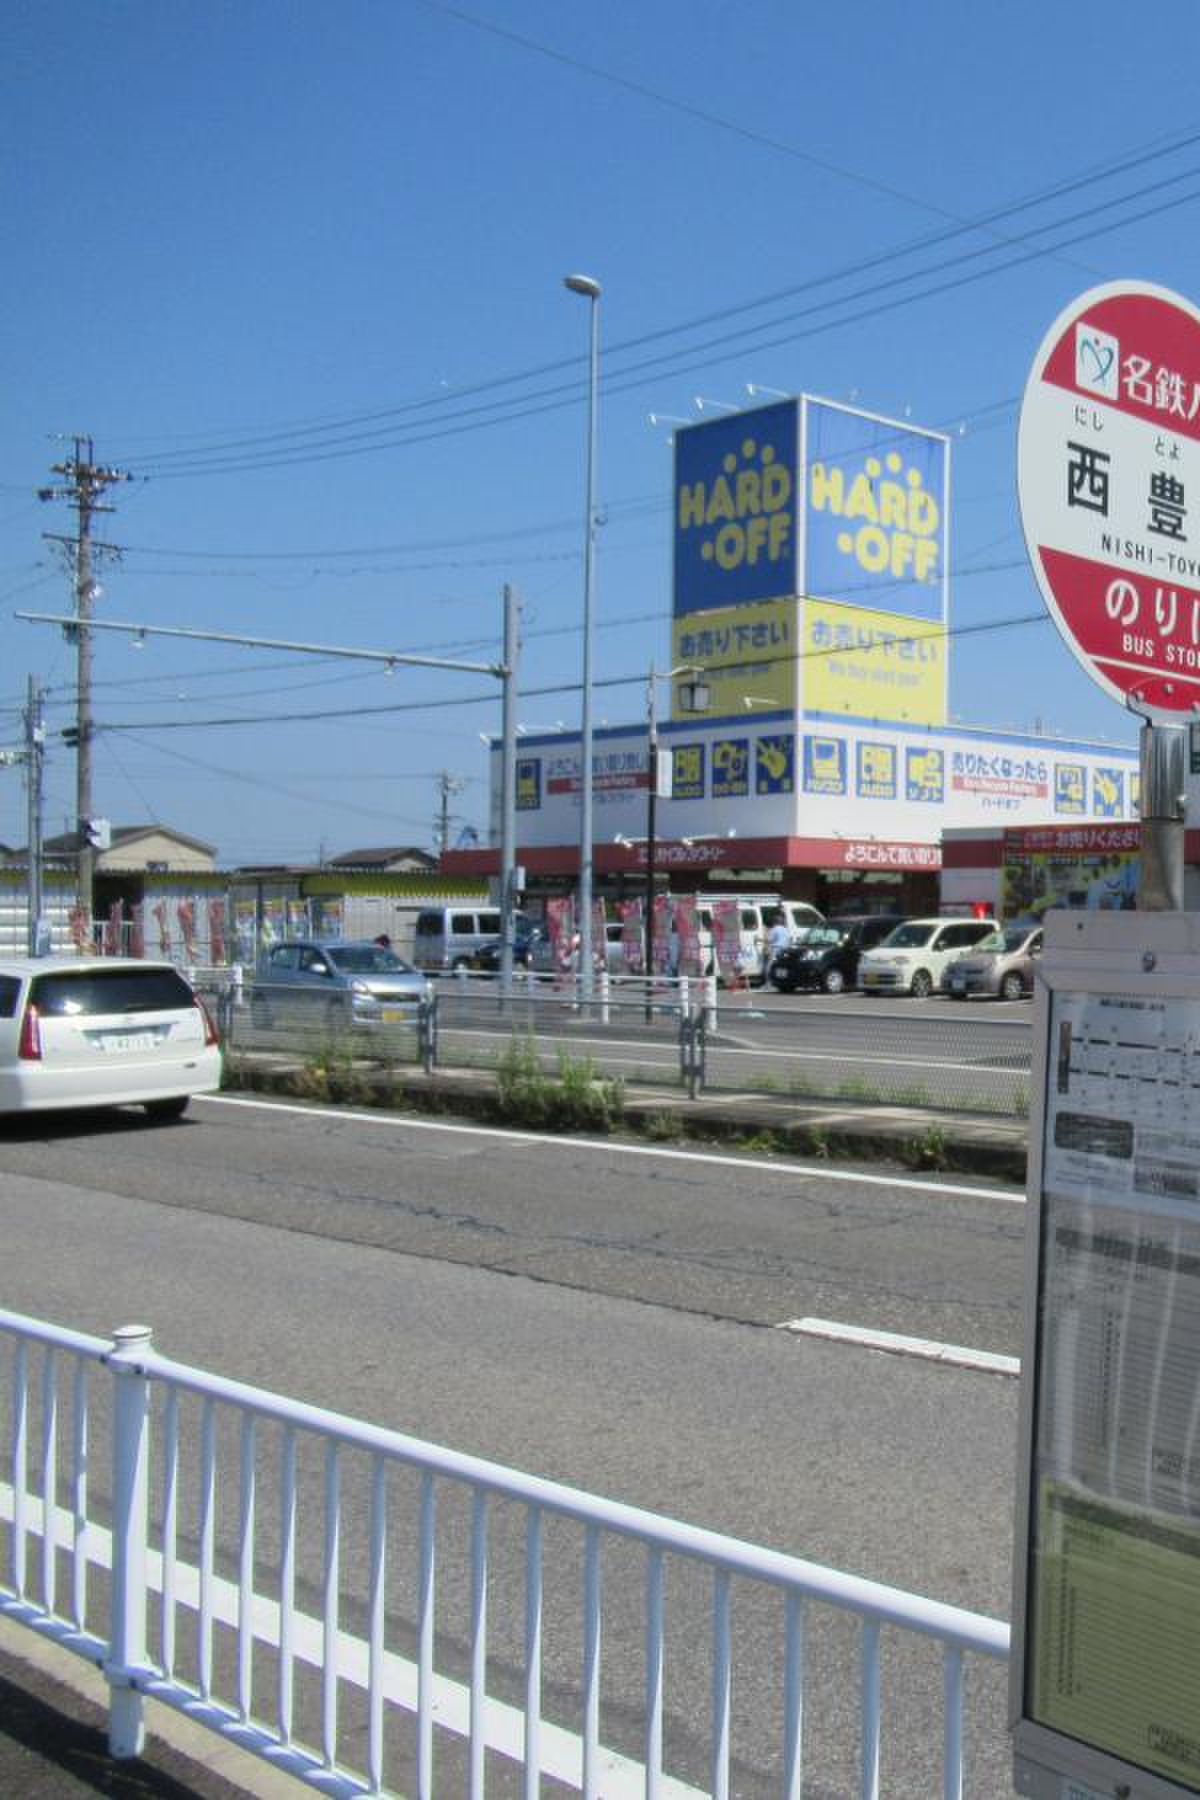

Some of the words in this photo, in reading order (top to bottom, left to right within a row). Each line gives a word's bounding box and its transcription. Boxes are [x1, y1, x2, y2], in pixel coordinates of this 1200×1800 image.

[1074, 404, 1104, 433] にし
[1154, 435, 1183, 460] とよ
[679, 463, 791, 529] HARD
[810, 462, 939, 536] HARD
[715, 511, 792, 570] OFF
[855, 525, 938, 581] OFF
[1122, 633, 1155, 658] BUS
